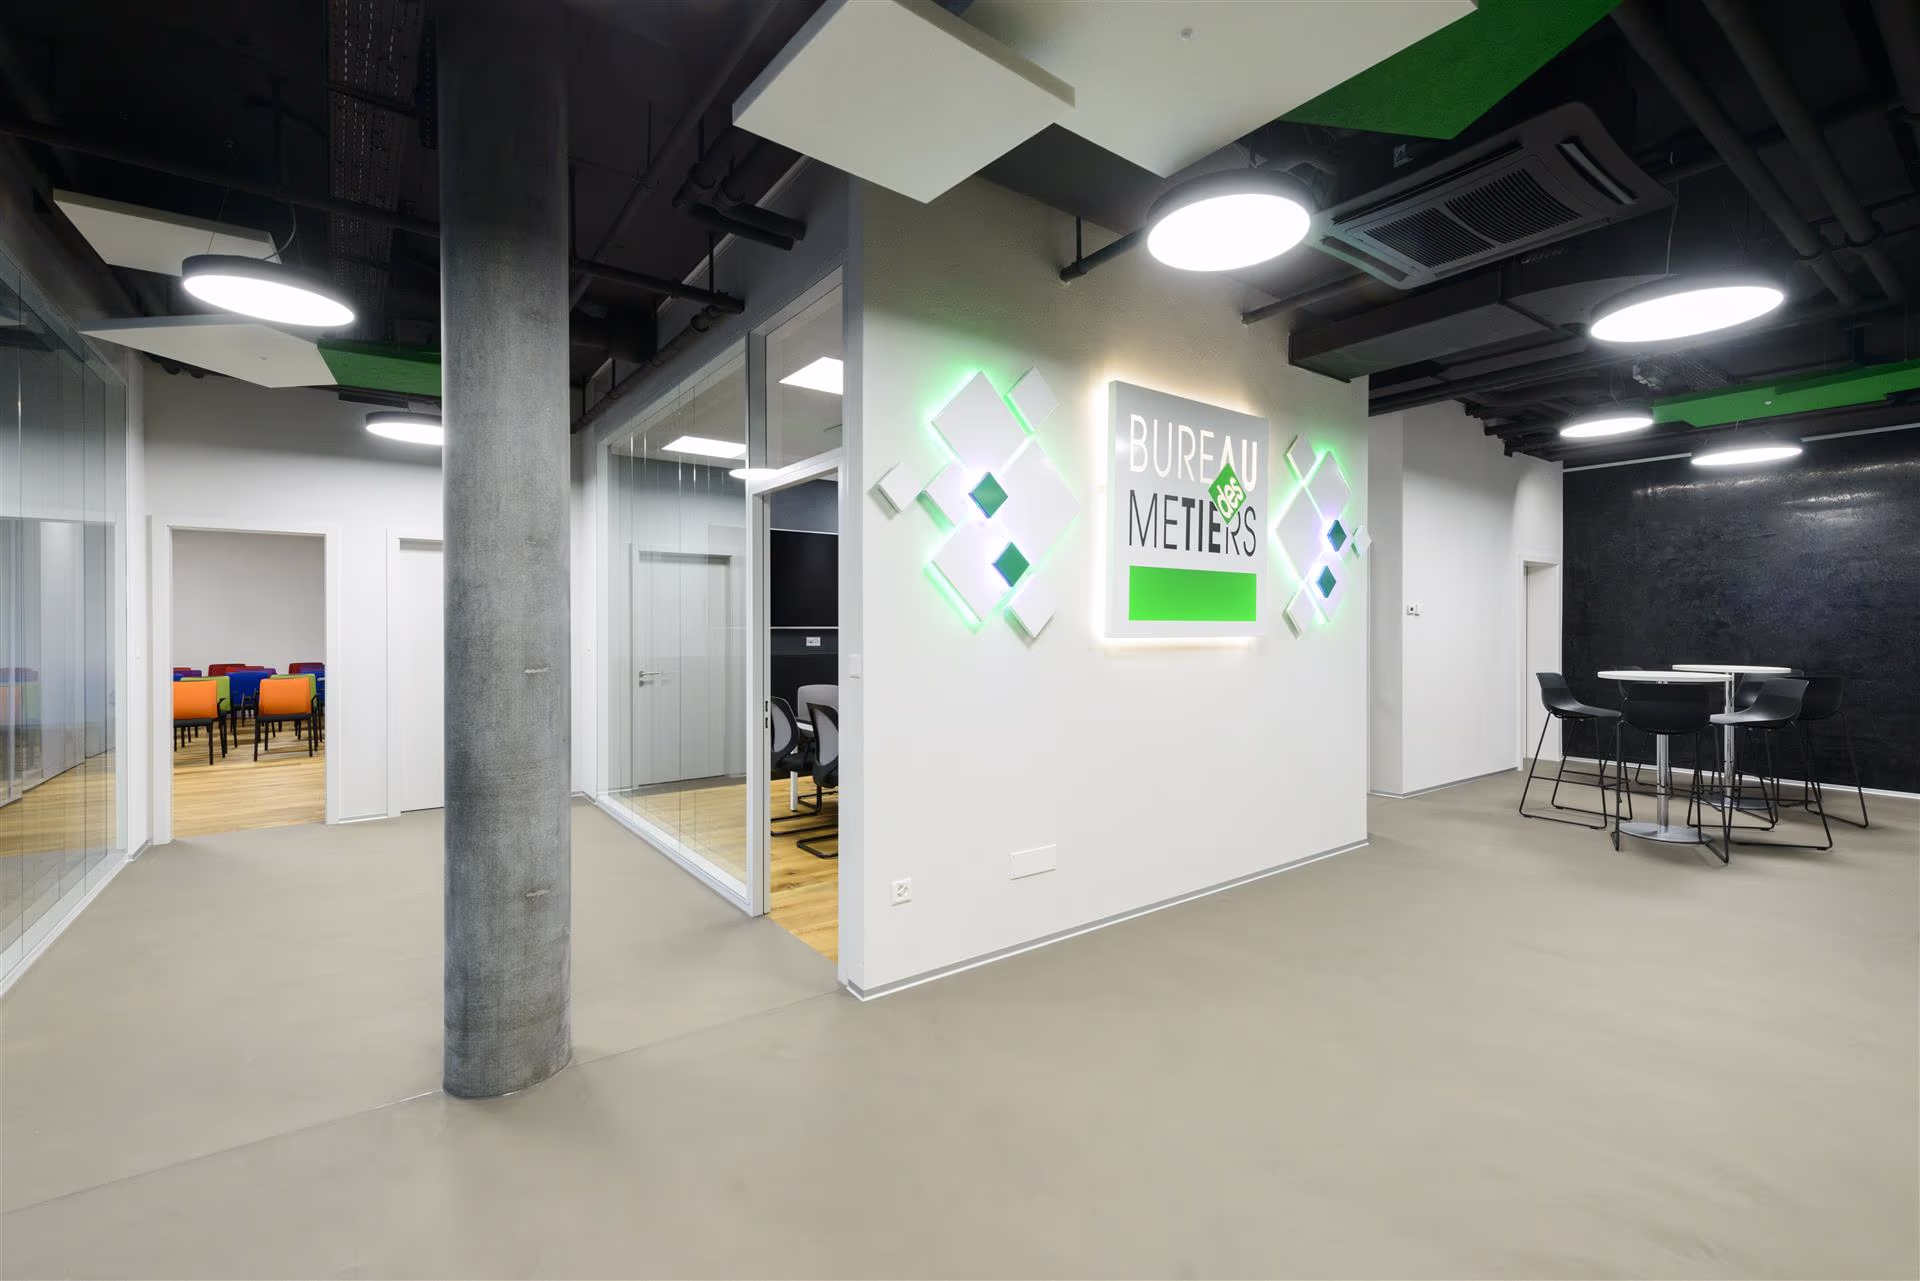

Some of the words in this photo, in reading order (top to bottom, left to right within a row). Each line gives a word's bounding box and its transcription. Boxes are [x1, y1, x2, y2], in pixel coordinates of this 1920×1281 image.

[1130, 414, 1257, 492] BUREAU
[1129, 489, 1257, 557] METIERS
[1216, 476, 1244, 519] des
